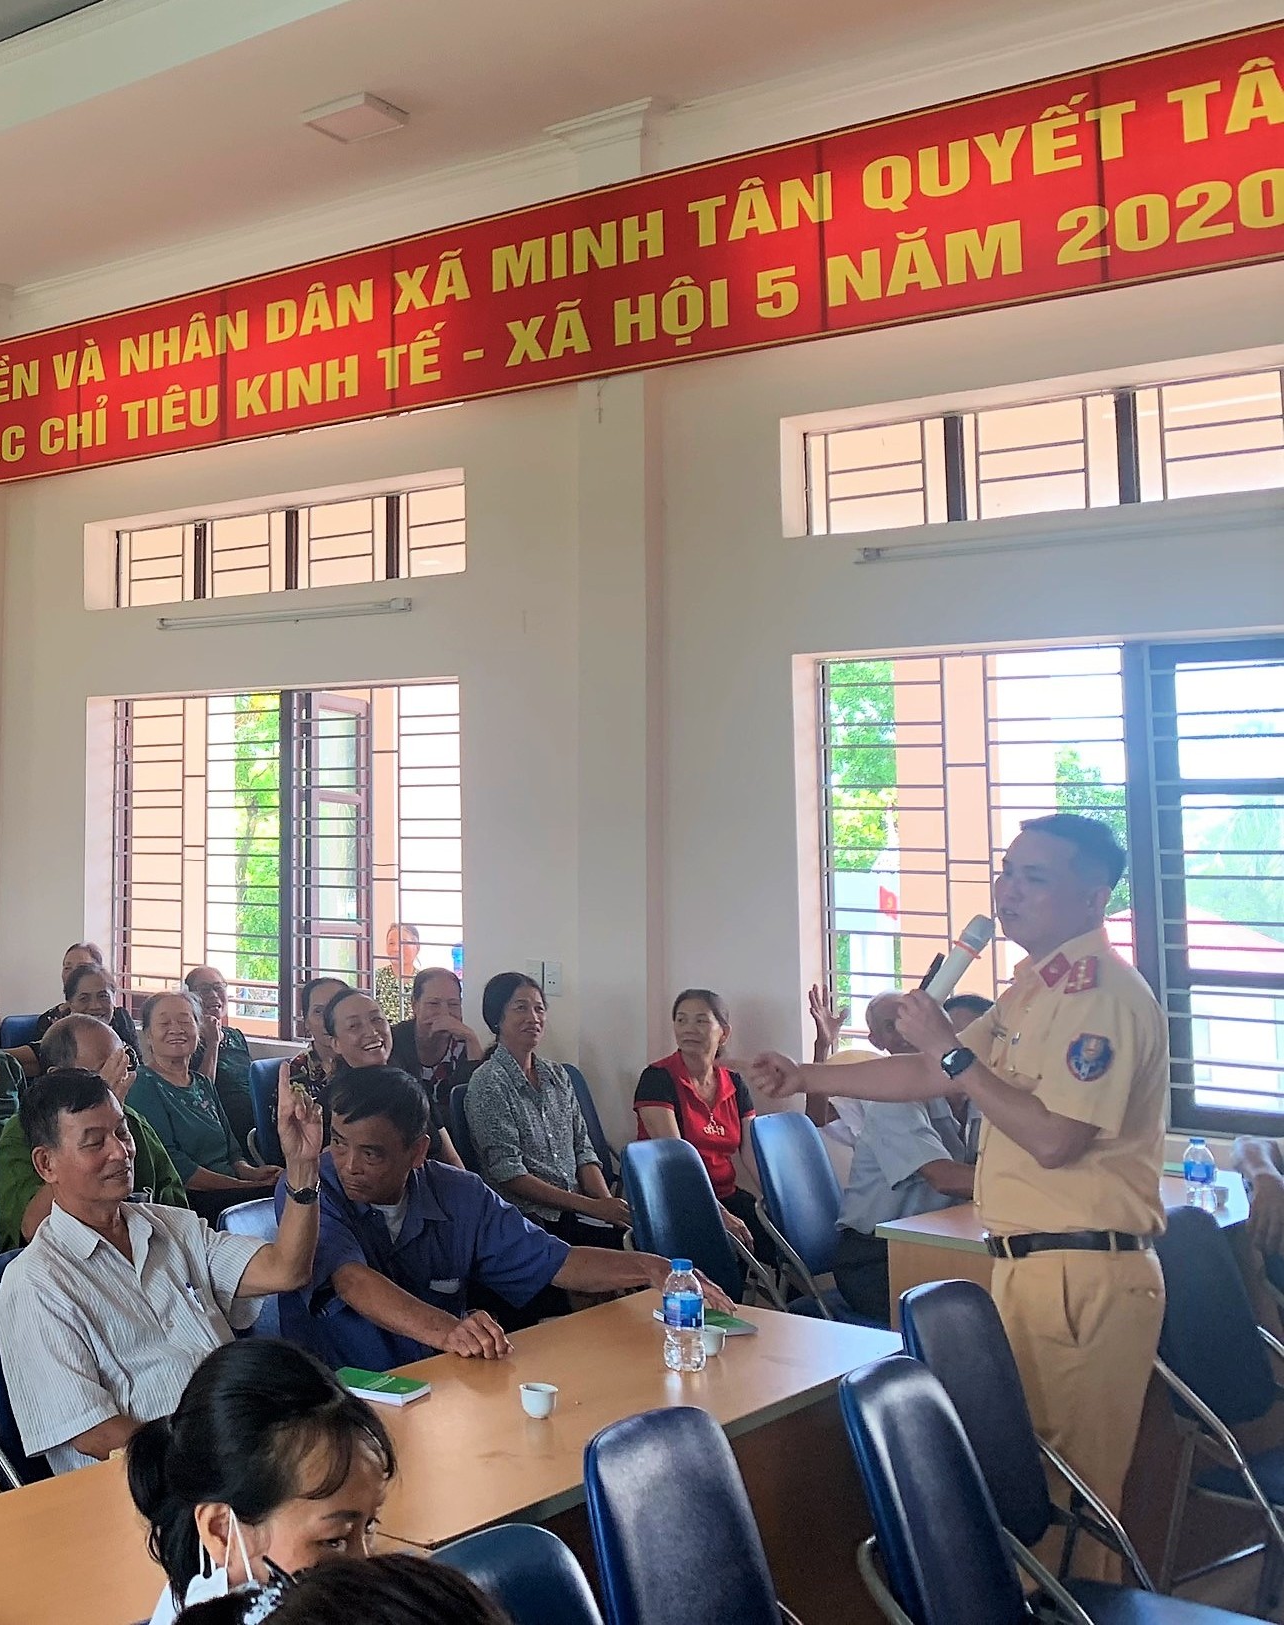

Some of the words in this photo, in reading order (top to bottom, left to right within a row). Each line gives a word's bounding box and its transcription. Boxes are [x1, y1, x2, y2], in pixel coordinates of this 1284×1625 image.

[39, 393, 107, 456] CHỈ
[121, 384, 219, 441] TIÊU
[236, 354, 359, 419] KINH
[376, 322, 448, 390] TẾ
[462, 347, 485, 362] -
[507, 299, 591, 367] XÃ
[614, 276, 729, 347] HỘI
[755, 265, 799, 319] 5
[826, 226, 1023, 308] NĂM
[1056, 168, 1284, 266] 2020
[52, 341, 107, 390] VÀ
[119, 310, 248, 377] NHÂN
[266, 280, 374, 344] DÂN
[393, 248, 471, 315] XÃ
[492, 209, 664, 293] MINH
[687, 174, 833, 247] TÂN
[862, 92, 1136, 213] QUYẾT
[1167, 55, 1284, 144] TÂ
